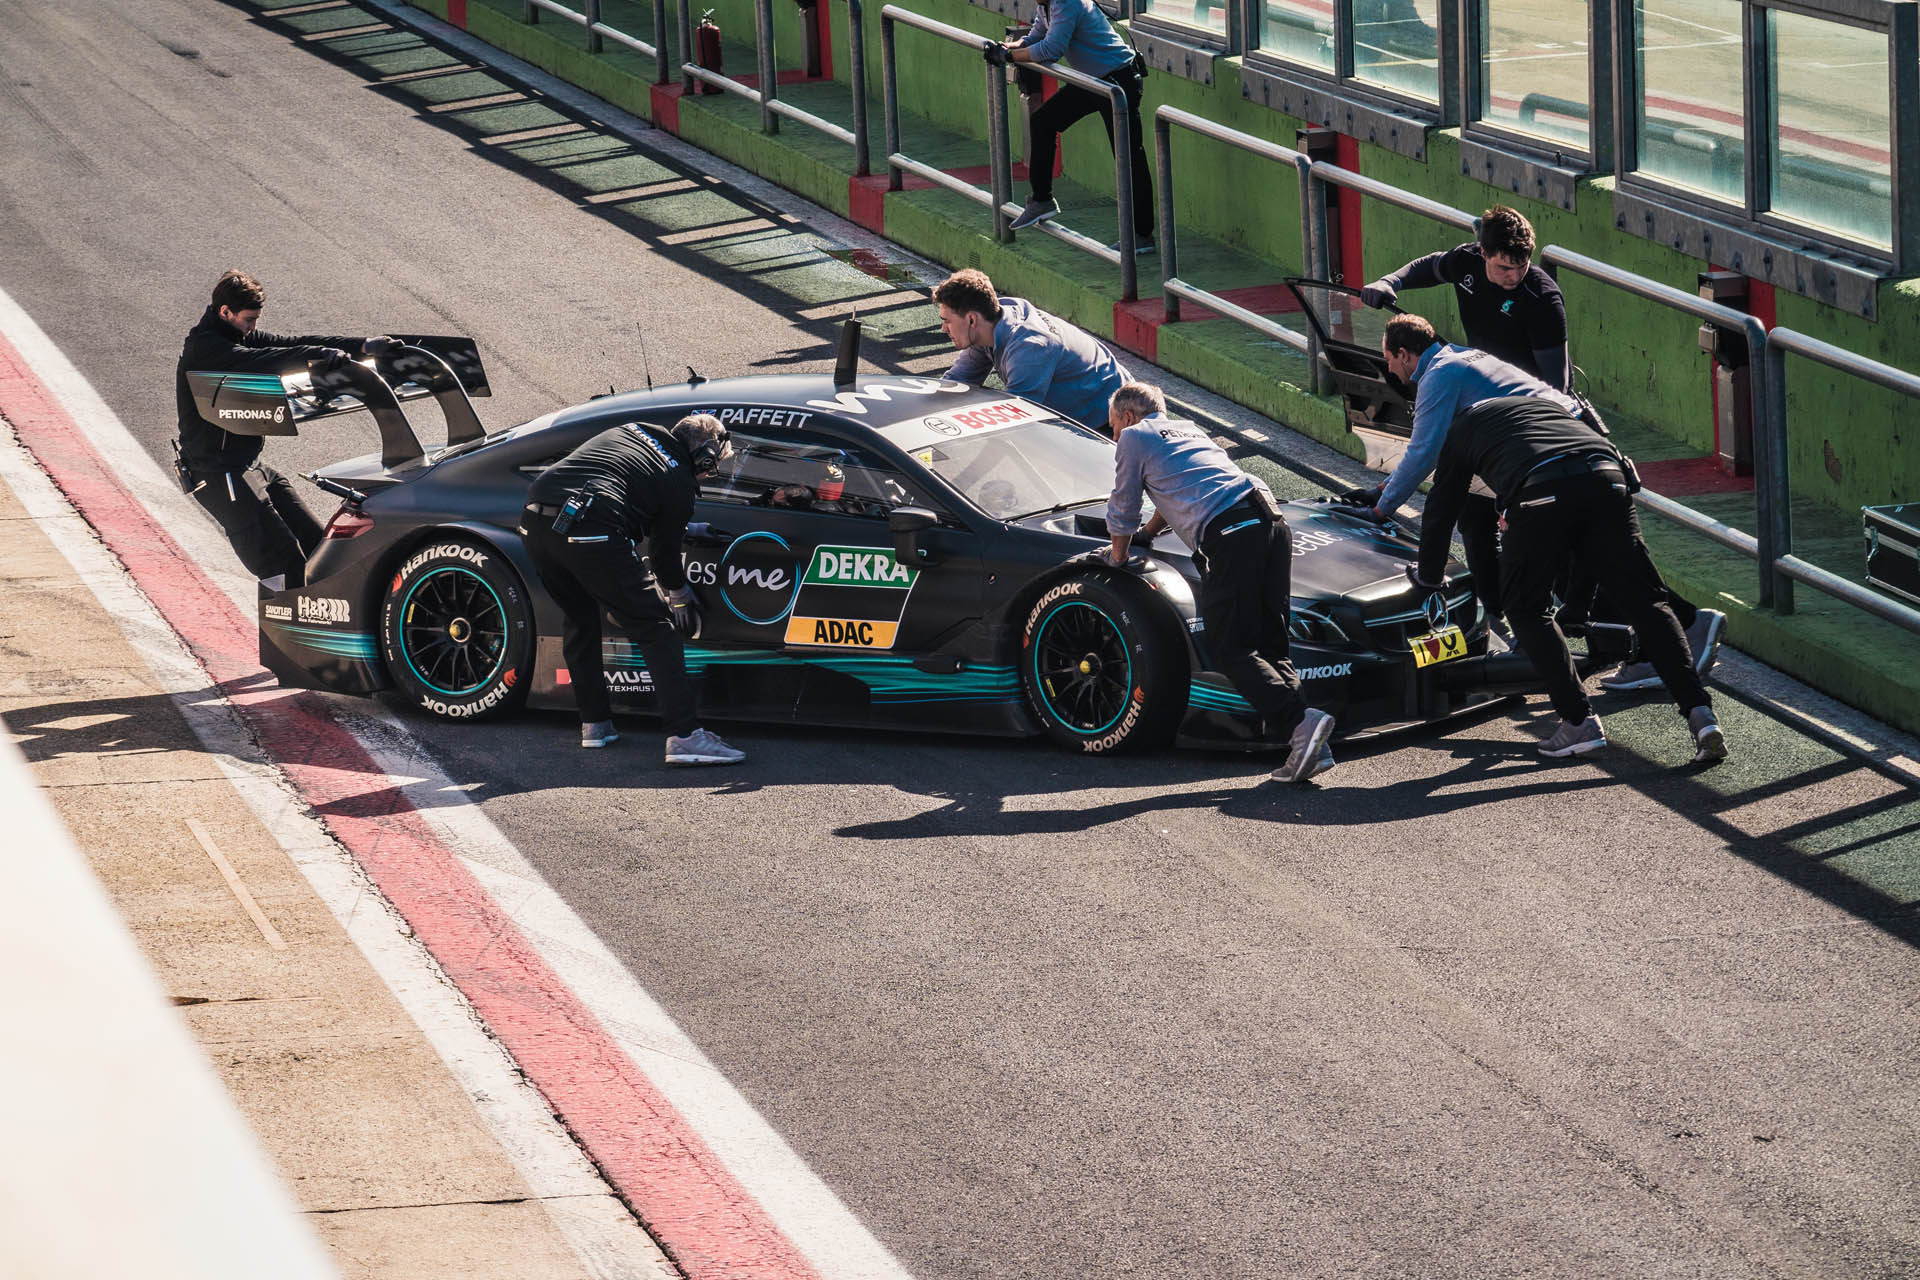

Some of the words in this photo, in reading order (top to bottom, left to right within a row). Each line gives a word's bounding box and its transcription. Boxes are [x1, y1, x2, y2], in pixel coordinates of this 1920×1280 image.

[218, 409, 273, 419] PETRONAS
[720, 408, 813, 429] PAFFETT
[952, 403, 1033, 430] BOSCH
[728, 565, 791, 591] me
[818, 552, 909, 583] DEKRA
[297, 595, 331, 620] H&R
[814, 620, 874, 645] ADAC
